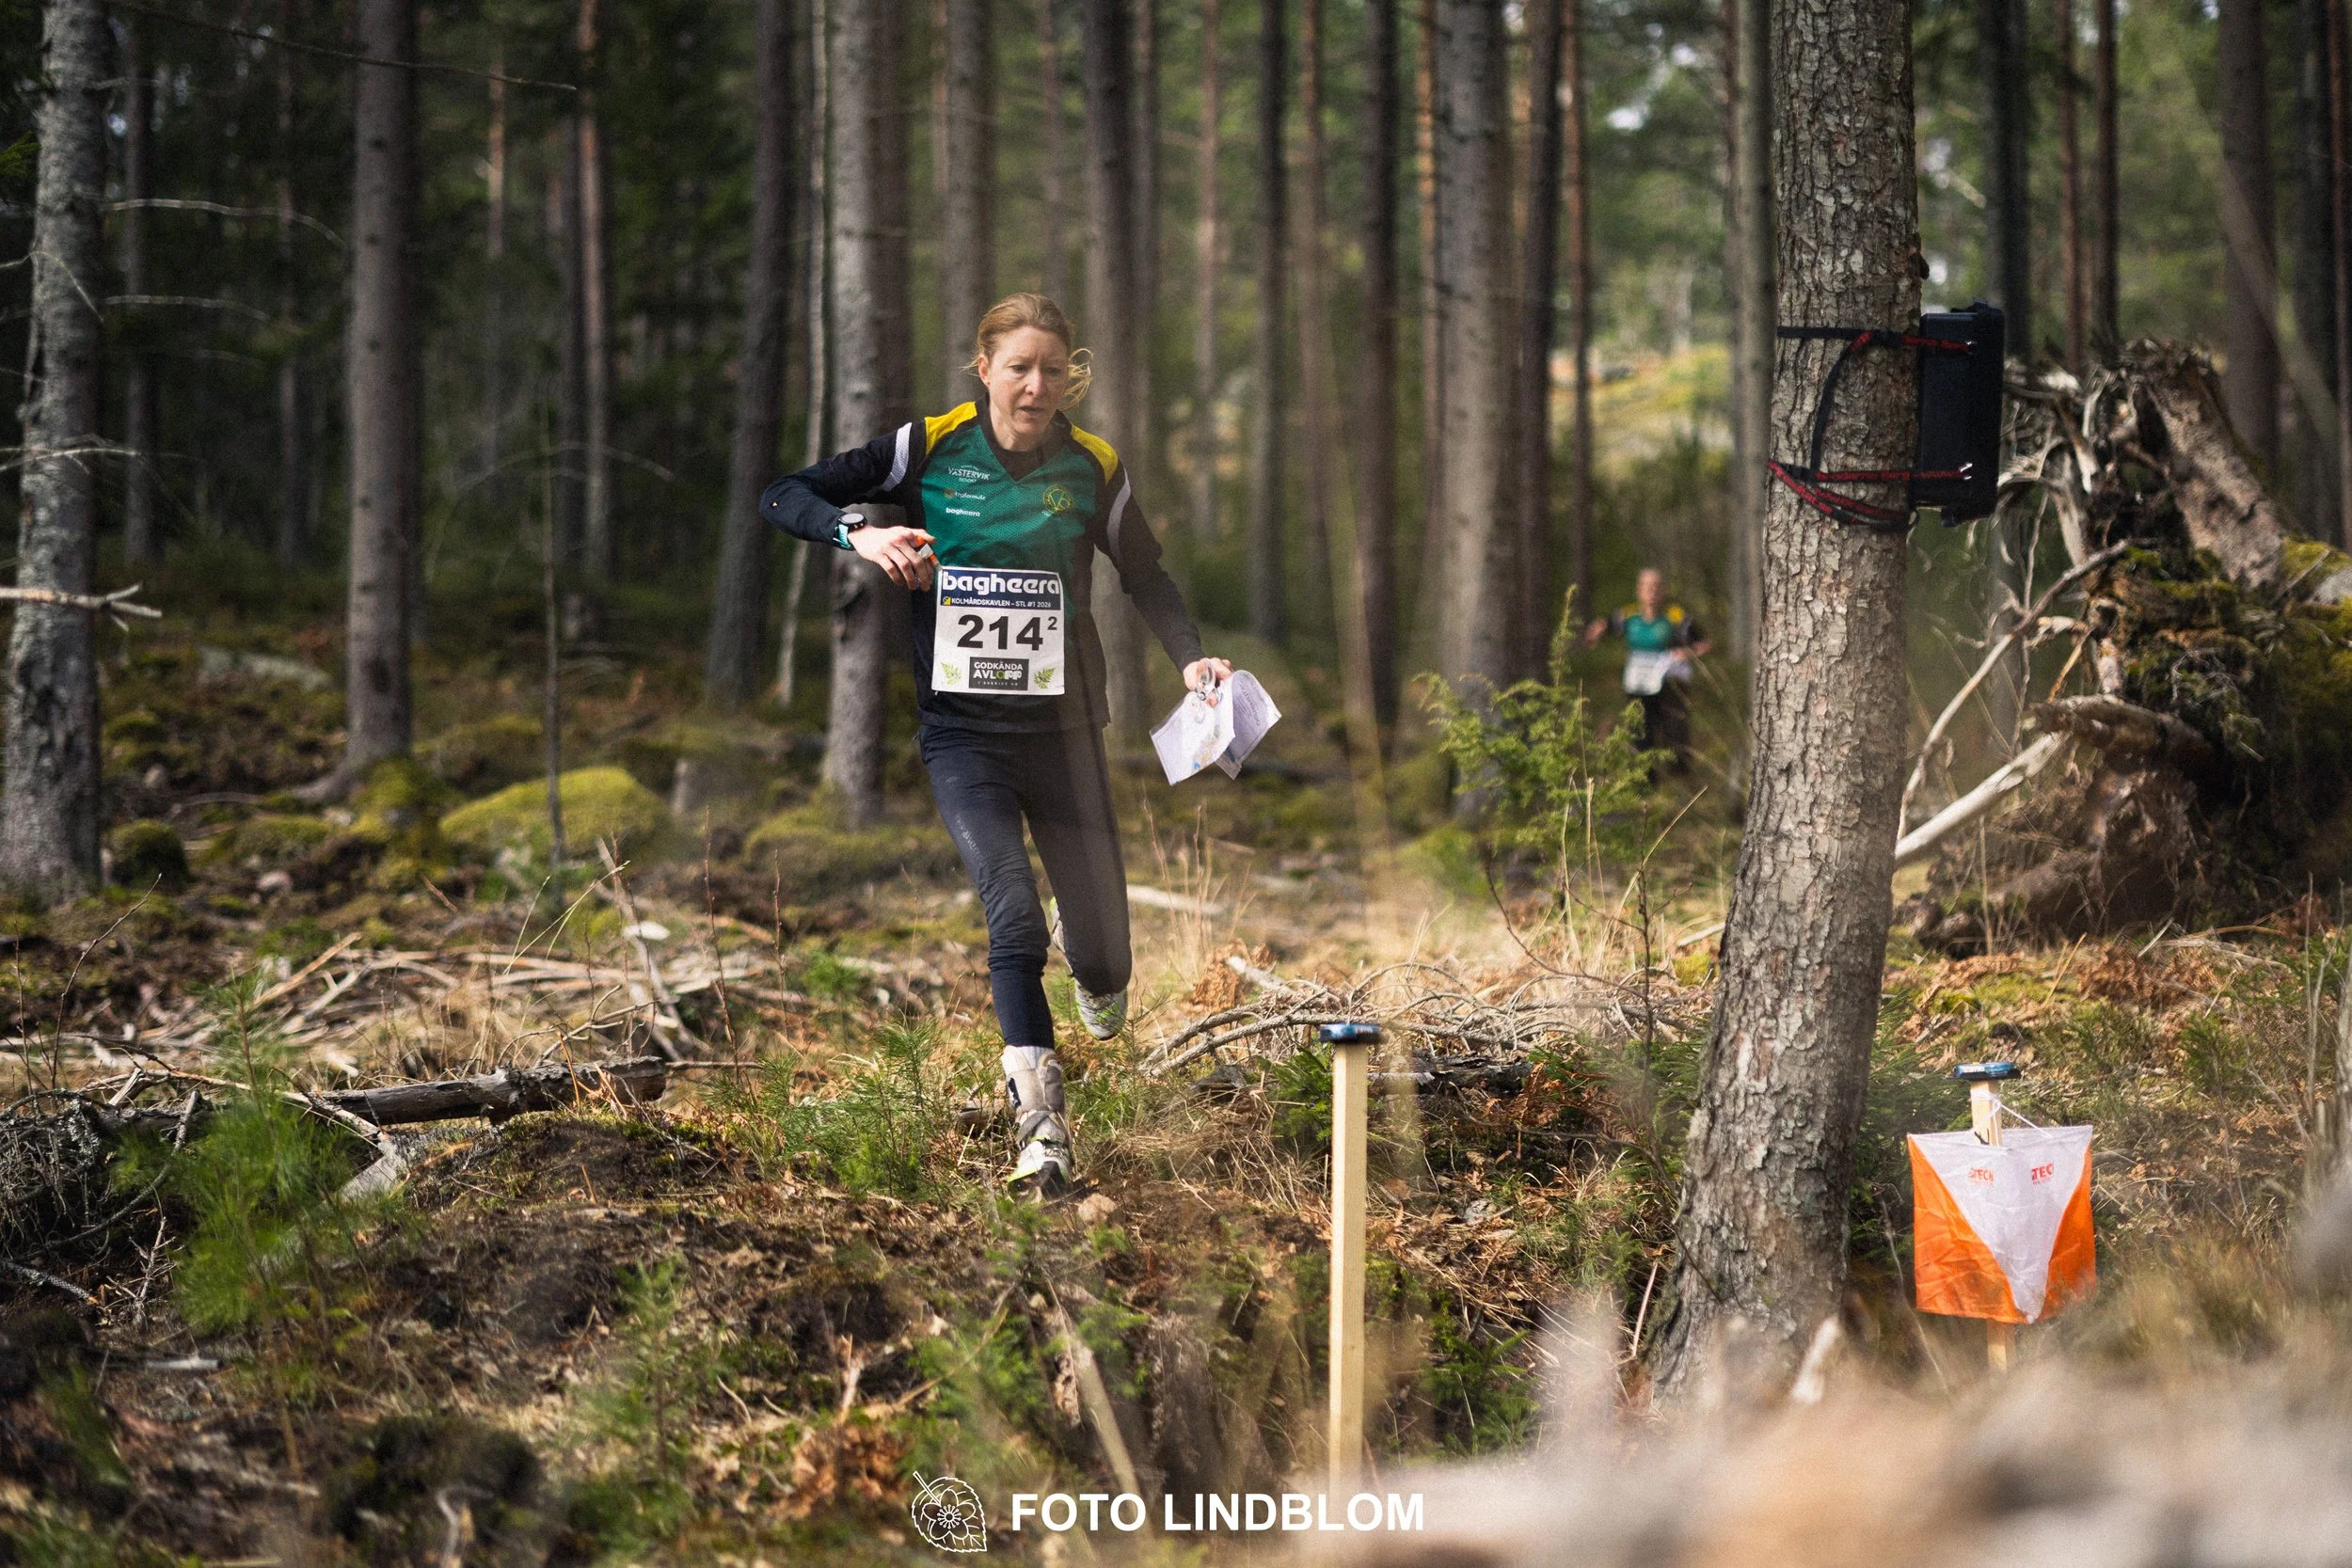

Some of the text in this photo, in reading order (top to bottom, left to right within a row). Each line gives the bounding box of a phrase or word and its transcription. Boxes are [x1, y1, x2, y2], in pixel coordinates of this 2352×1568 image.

[946, 507, 980, 517] bagheera
[942, 571, 1060, 595] bagheera
[951, 596, 1010, 607] KOLMÅRDSKAVLEN
[957, 614, 1043, 651] 214
[974, 660, 1024, 671] GODKÄNDA
[973, 669, 1023, 680] AVLOPP
